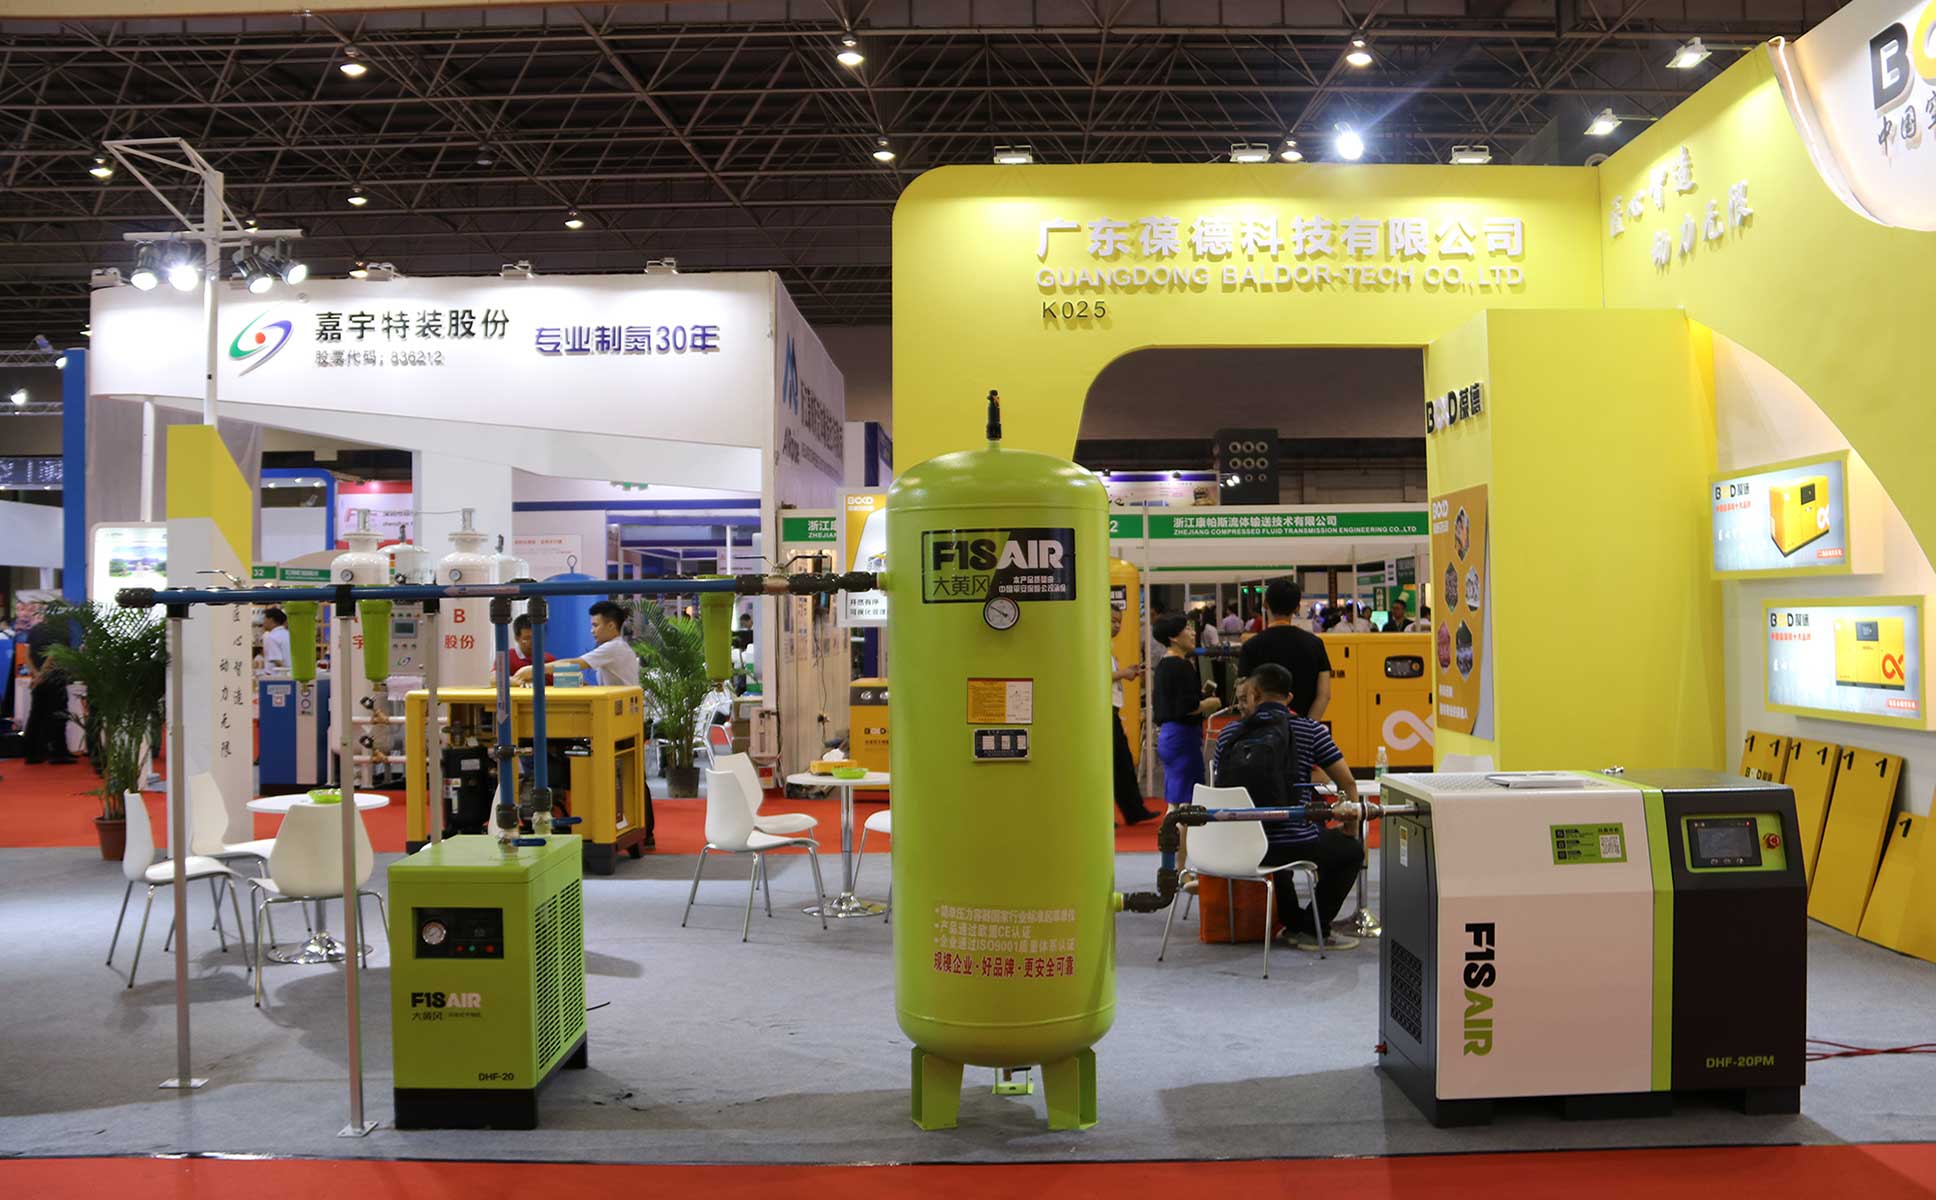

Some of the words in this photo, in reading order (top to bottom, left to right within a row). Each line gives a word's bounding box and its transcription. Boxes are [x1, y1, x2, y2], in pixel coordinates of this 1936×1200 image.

[1037, 214, 1524, 257] 广东葆德科技有限公司
[1036, 266, 1210, 288] GUANGDONG
[1222, 264, 1414, 286] BALDOR-TECH
[1042, 301, 1107, 320] K025
[315, 309, 510, 342] 嘉宇特装股份
[534, 324, 720, 355] 专业制氮30年
[1173, 528, 1210, 536] ZHEJIANG
[1211, 527, 1261, 535] COMPRESSED
[1262, 527, 1283, 535] FLUID
[1284, 526, 1338, 534] TRANSMISSION
[1339, 526, 1387, 534] ENGINEERING
[932, 575, 991, 597] 大黄风
[453, 608, 466, 624] B
[444, 634, 476, 650] 股份
[1705, 1054, 1775, 1069] DHF-20PM
[478, 1072, 515, 1081] DHF-20
